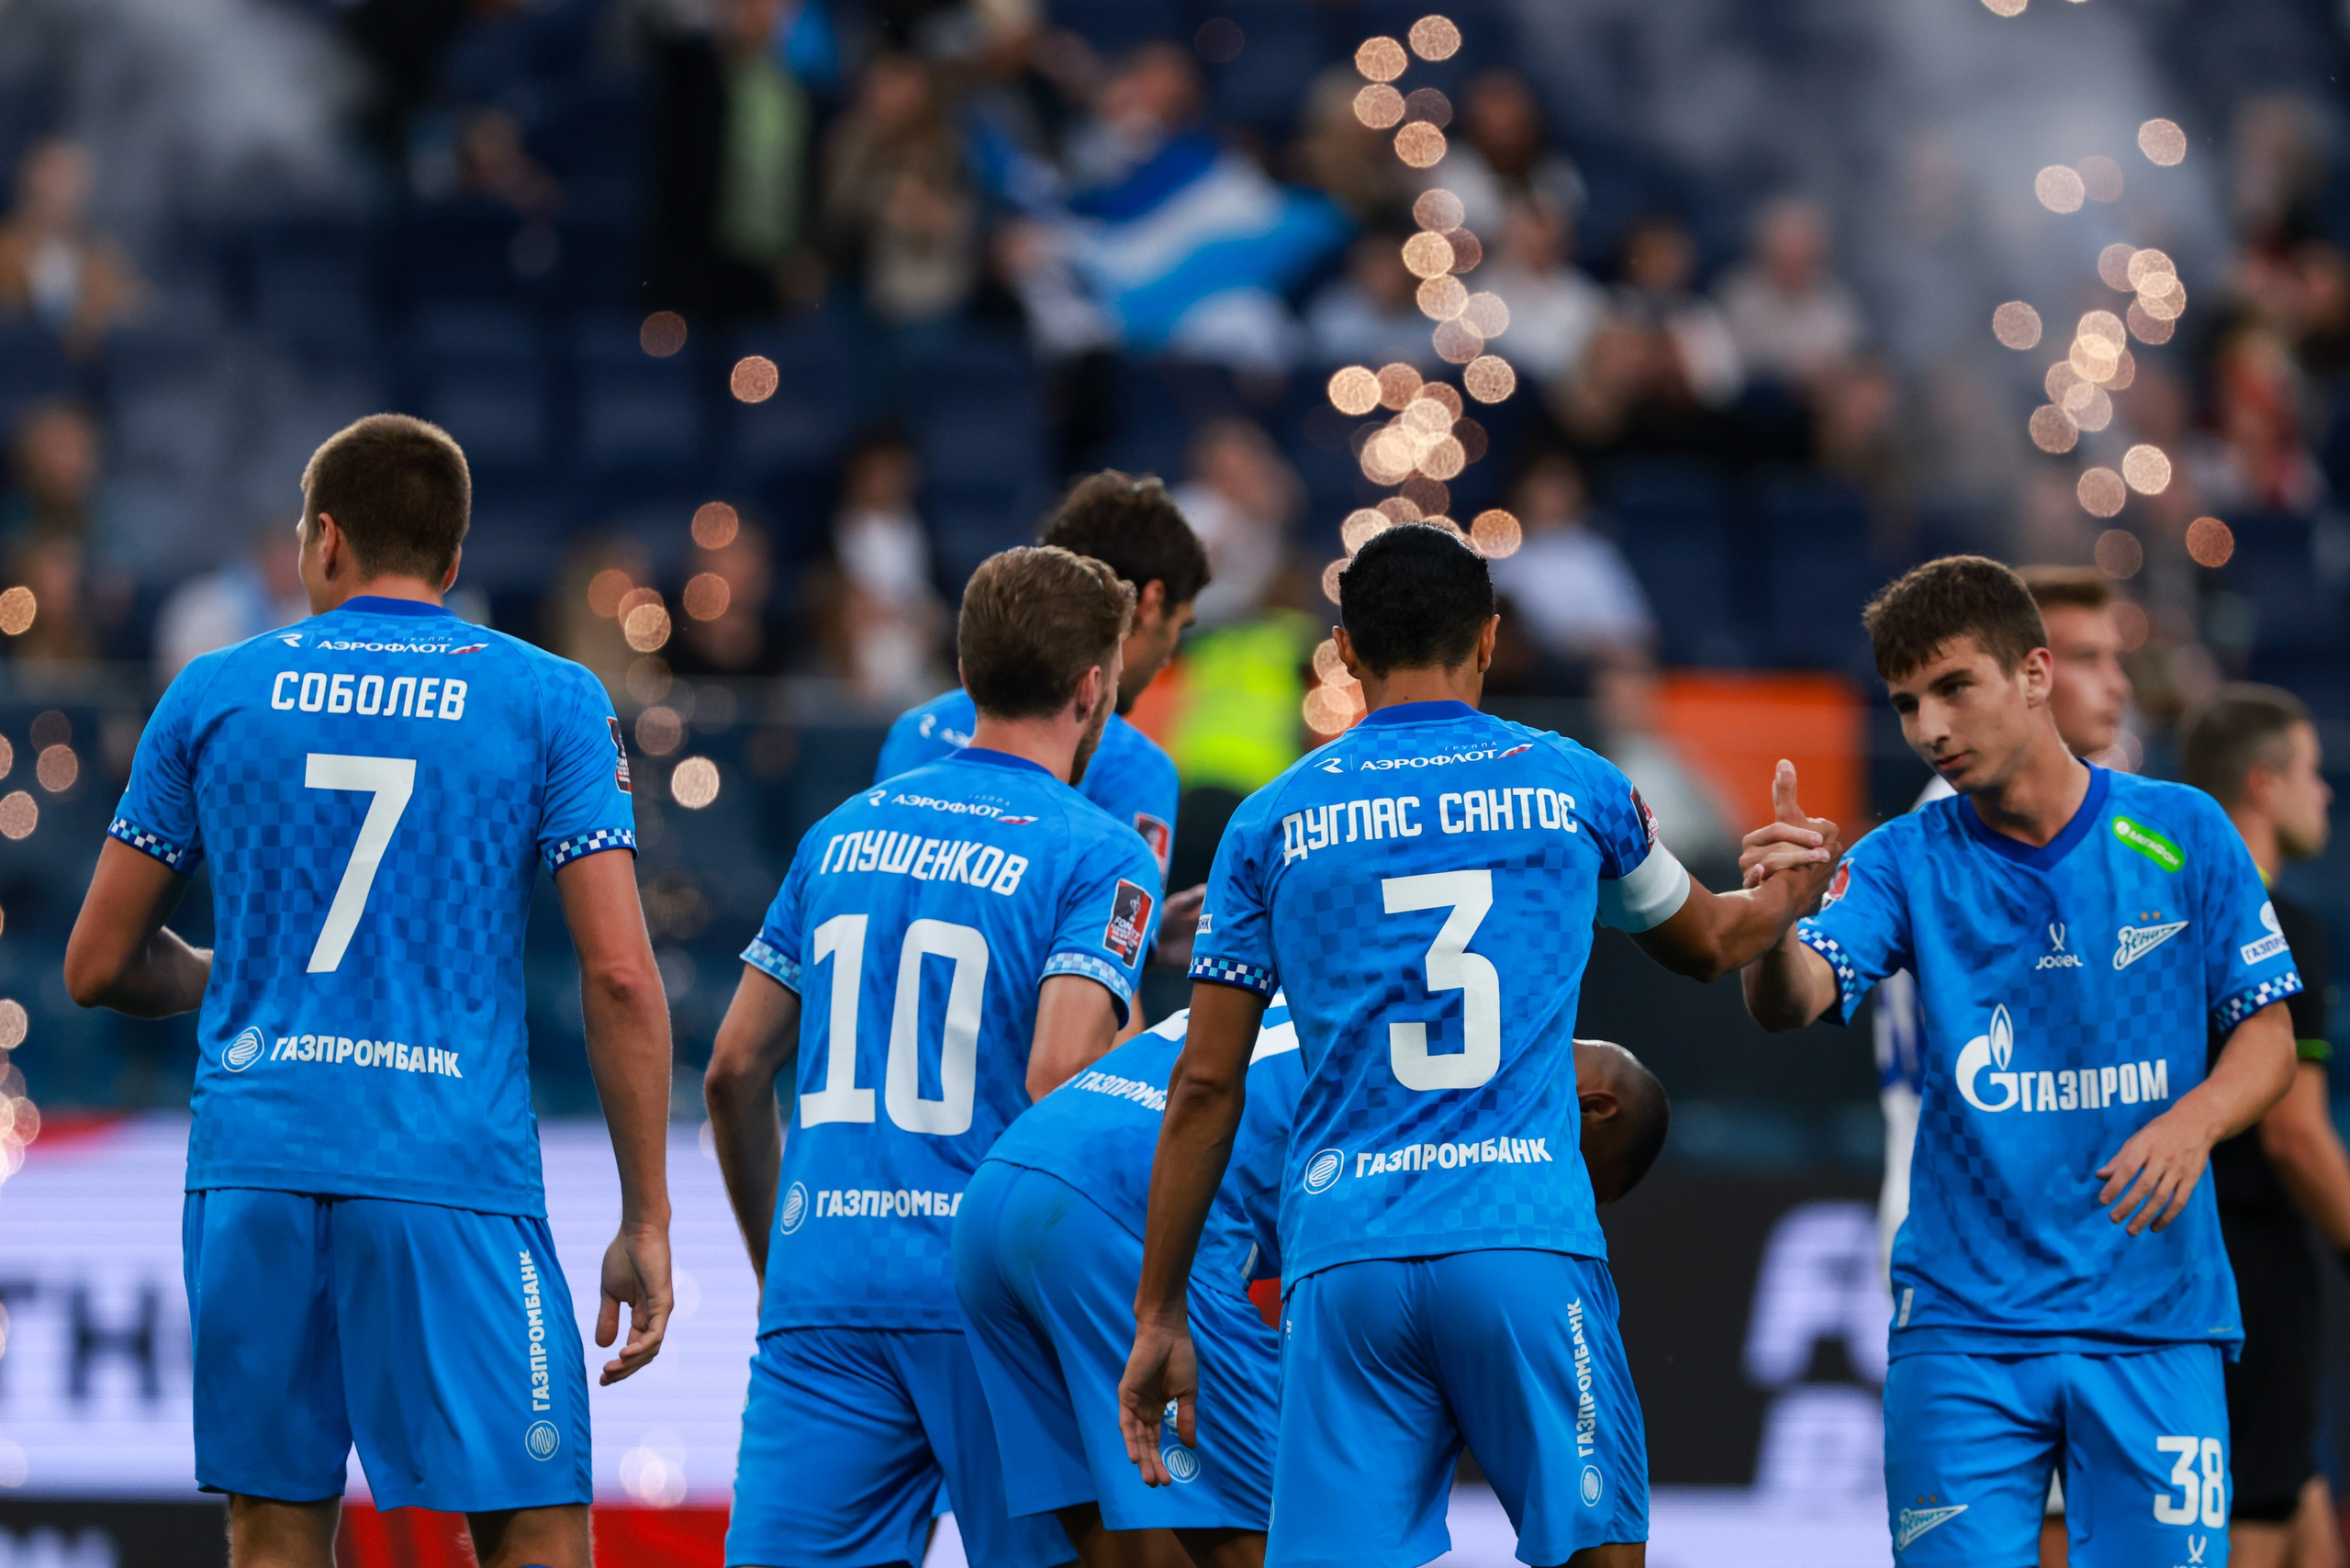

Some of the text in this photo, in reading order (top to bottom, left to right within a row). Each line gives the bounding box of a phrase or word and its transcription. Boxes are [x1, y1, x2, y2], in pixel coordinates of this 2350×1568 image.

[317, 640, 451, 654] АЭРОФЛОТ
[271, 670, 468, 721] СОБОЛЕВ
[1360, 748, 1498, 771] АЭРОФЛОТ
[1445, 740, 1497, 751] ГРУППА
[892, 793, 1004, 818] АЭРОФЛОТ
[1281, 796, 1423, 867] ДУГЛАС
[1438, 787, 1578, 834] САНТОС
[304, 753, 417, 974] 7
[820, 829, 1030, 896] ГЛУШЕНКОВ
[1381, 869, 1501, 1092] 3
[800, 913, 990, 1137] 10
[270, 1034, 463, 1079] ГАЗПРОМБАНК
[2020, 1058, 2169, 1113] ГАЗПРОМ
[1355, 1136, 1553, 1179] ГАЗПРОМБАНК
[520, 1249, 551, 1411] ГАЗПРОМБАНК
[1566, 1297, 1596, 1457] ГАЗПРОМБАНК
[2153, 1436, 2225, 1529] 38
